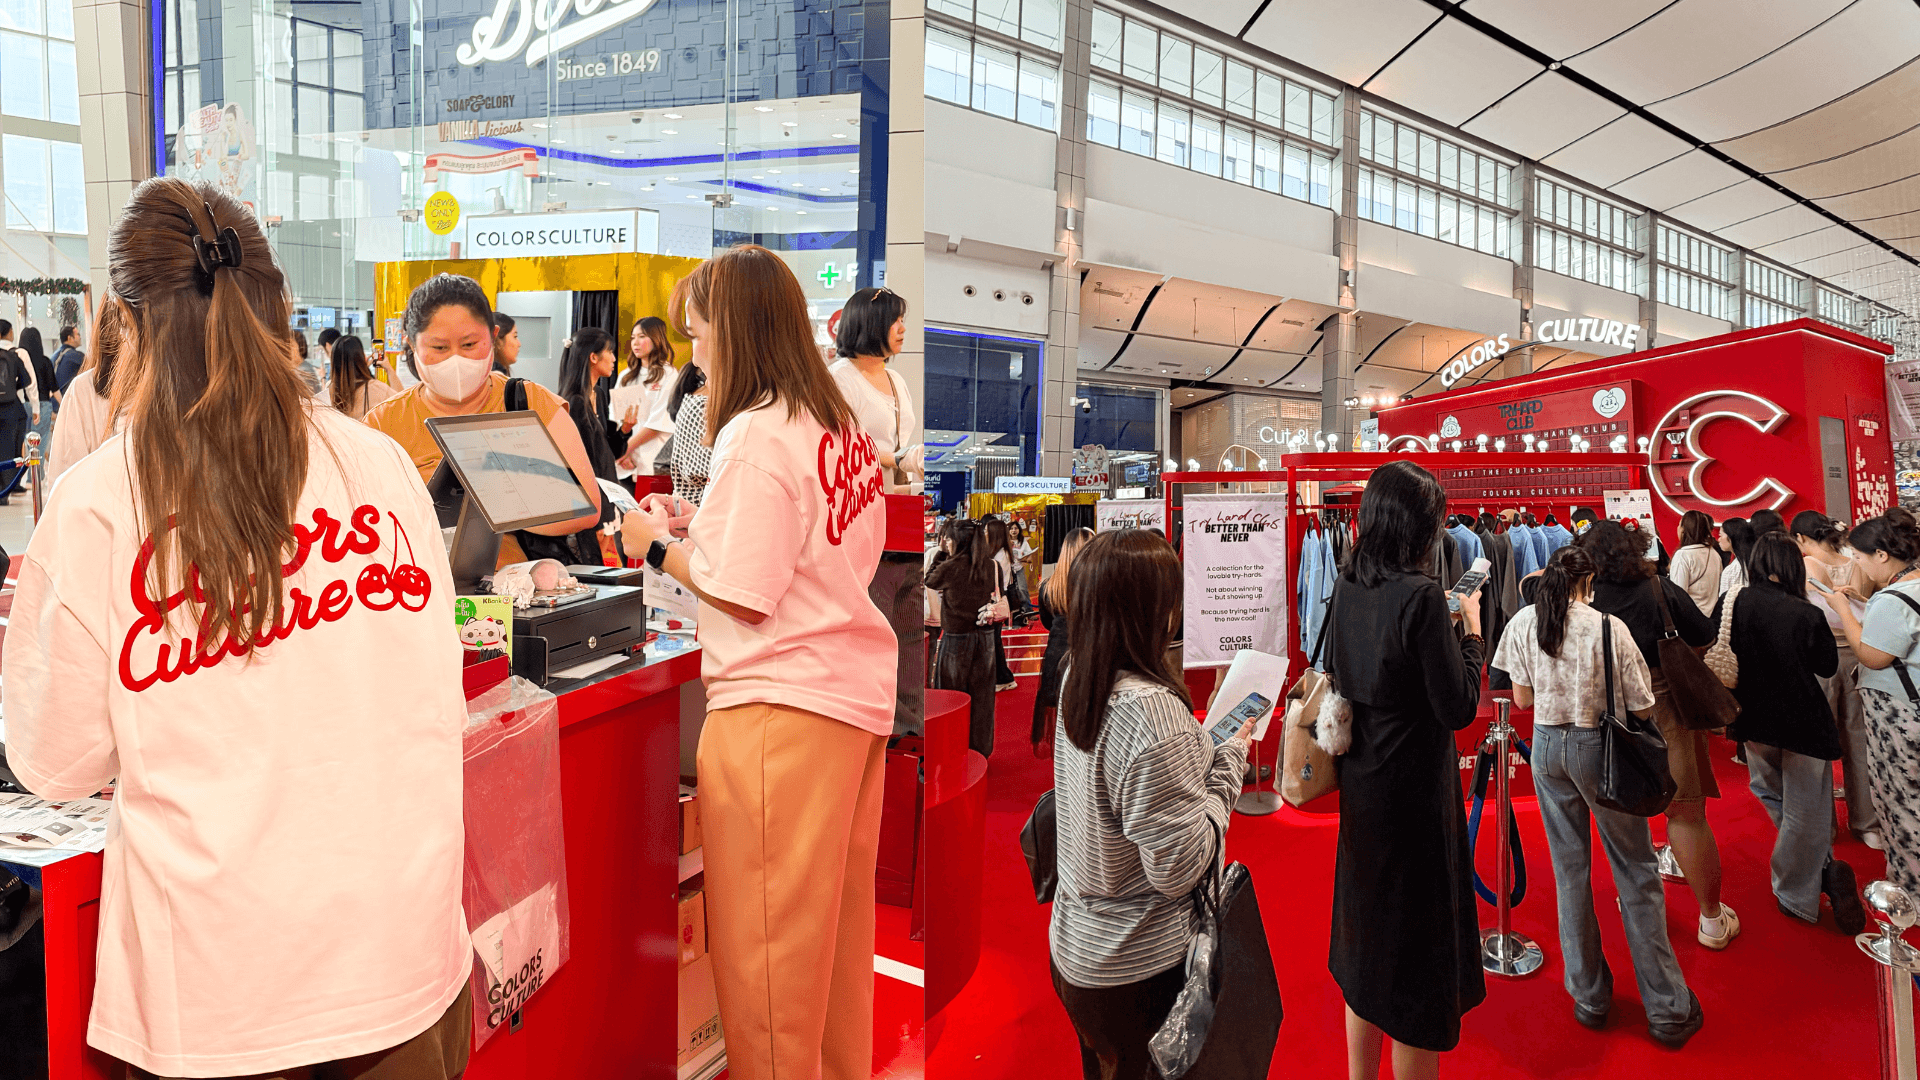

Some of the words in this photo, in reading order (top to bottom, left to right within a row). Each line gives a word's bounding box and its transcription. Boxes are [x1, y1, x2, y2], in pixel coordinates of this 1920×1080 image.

[556, 58, 607, 80] Since
[611, 50, 660, 75] 1849
[446, 94, 515, 113] SOAP&GLORY
[476, 227, 627, 247] COLORSCULTURE
[1441, 333, 1510, 387] COLORS
[1537, 318, 1640, 349] CULTURE
[1507, 415, 1534, 431] CLUB
[1259, 426, 1291, 444] Cut
[1515, 428, 1573, 441] T-HARD
[1584, 423, 1617, 434] CLUB
[1453, 470, 1474, 478] JUST
[1002, 481, 1068, 489] COLORSCULTURE
[1482, 489, 1521, 497] COLORS
[1530, 487, 1583, 496] CULTURE
[1111, 519, 1135, 527] BETTER
[1205, 523, 1239, 534] BETTER
[1241, 522, 1265, 533] THAN
[1220, 532, 1250, 543] NEVER
[130, 504, 381, 618] Cors
[1238, 585, 1263, 593] winning
[1229, 607, 1248, 615] trying
[1219, 635, 1252, 643] COLORS
[1219, 643, 1253, 651] CULTURE
[1459, 755, 1479, 770] BET
[1508, 752, 1528, 765] THA
[487, 947, 542, 1005] COLORS
[486, 966, 544, 1029] CULTURE
